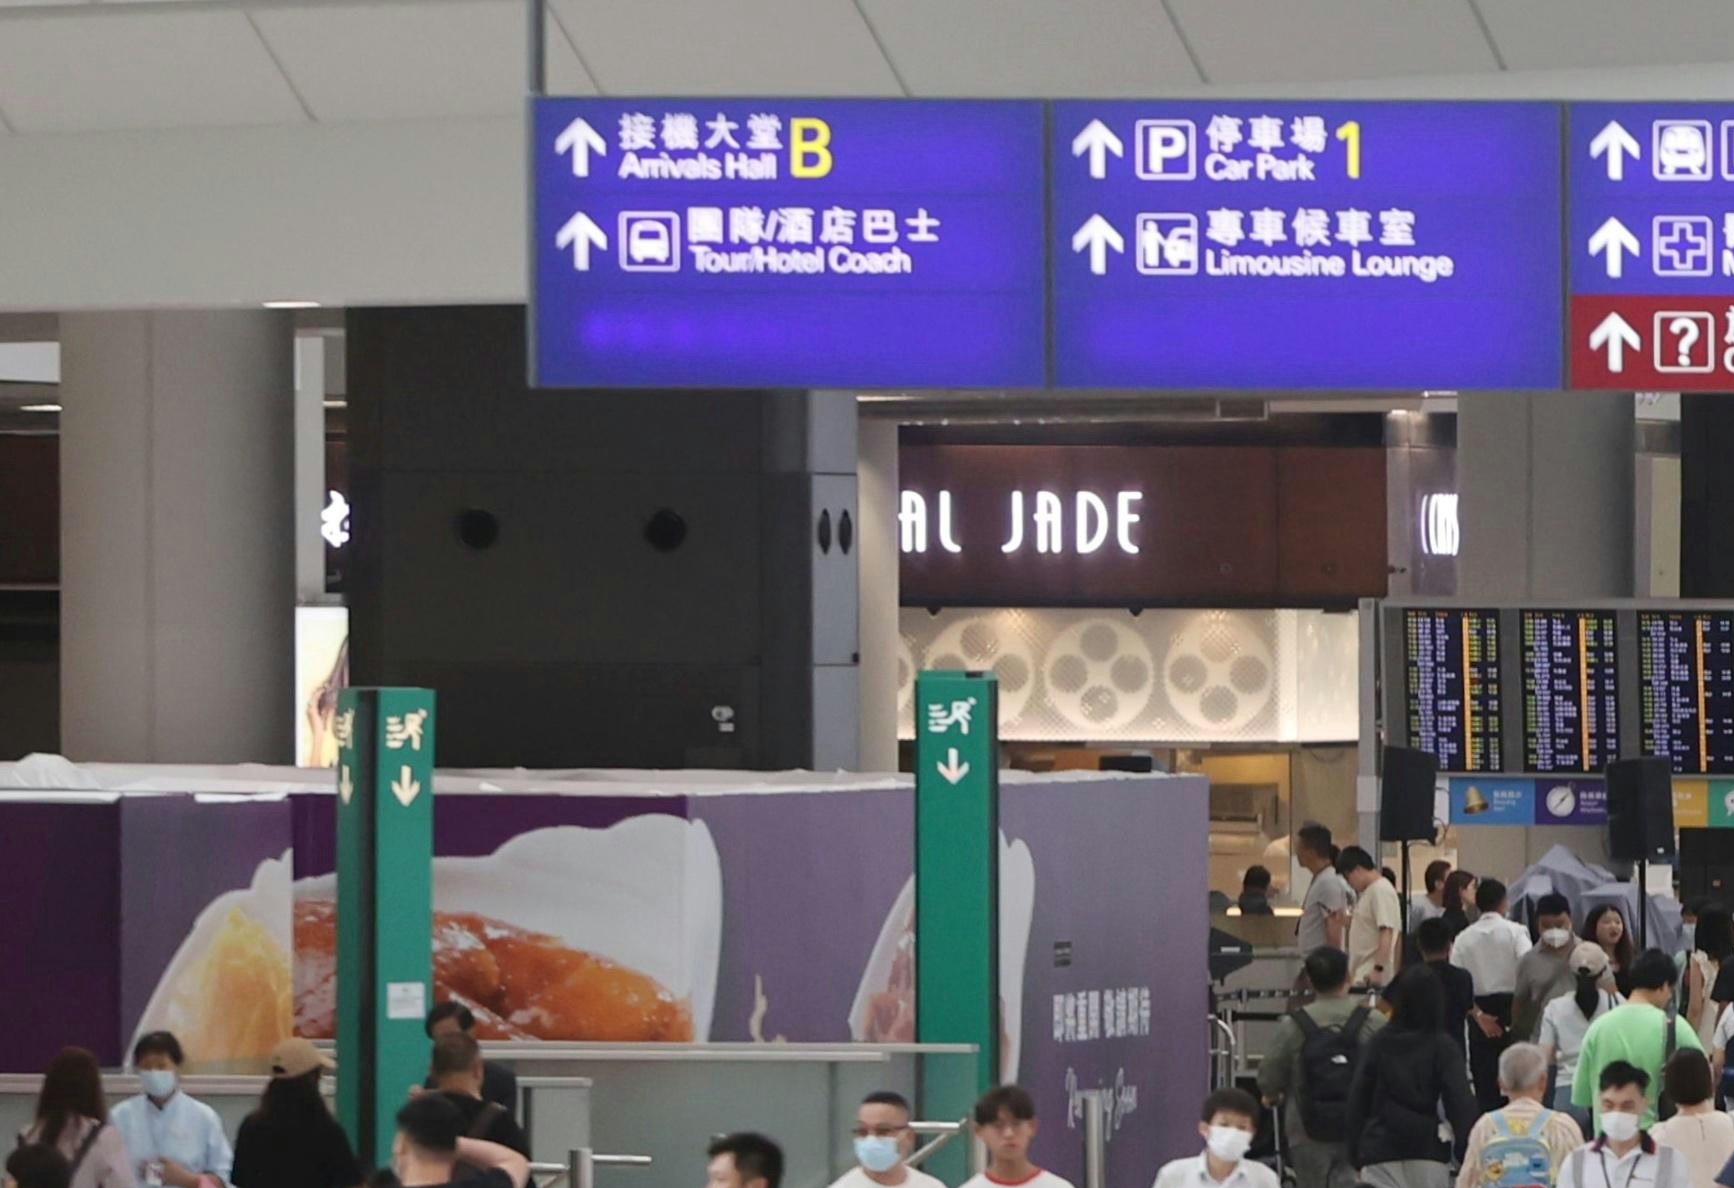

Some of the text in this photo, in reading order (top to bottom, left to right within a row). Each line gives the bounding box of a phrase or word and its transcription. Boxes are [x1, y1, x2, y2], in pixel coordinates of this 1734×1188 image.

[619, 113, 782, 153] 接機大堂
[791, 118, 832, 177] B
[1206, 115, 1327, 155] 停車場
[1336, 121, 1359, 178] 1
[619, 152, 776, 179] Arrivals Hall
[1205, 151, 1320, 180] Car Park
[688, 206, 940, 247] 團隊/酒店巴士
[1206, 208, 1415, 247] 專車候車室
[688, 245, 911, 273] Tour/Hotel Coach
[1206, 249, 1453, 282] Limousine Lounge
[1002, 491, 1142, 554] JADE
